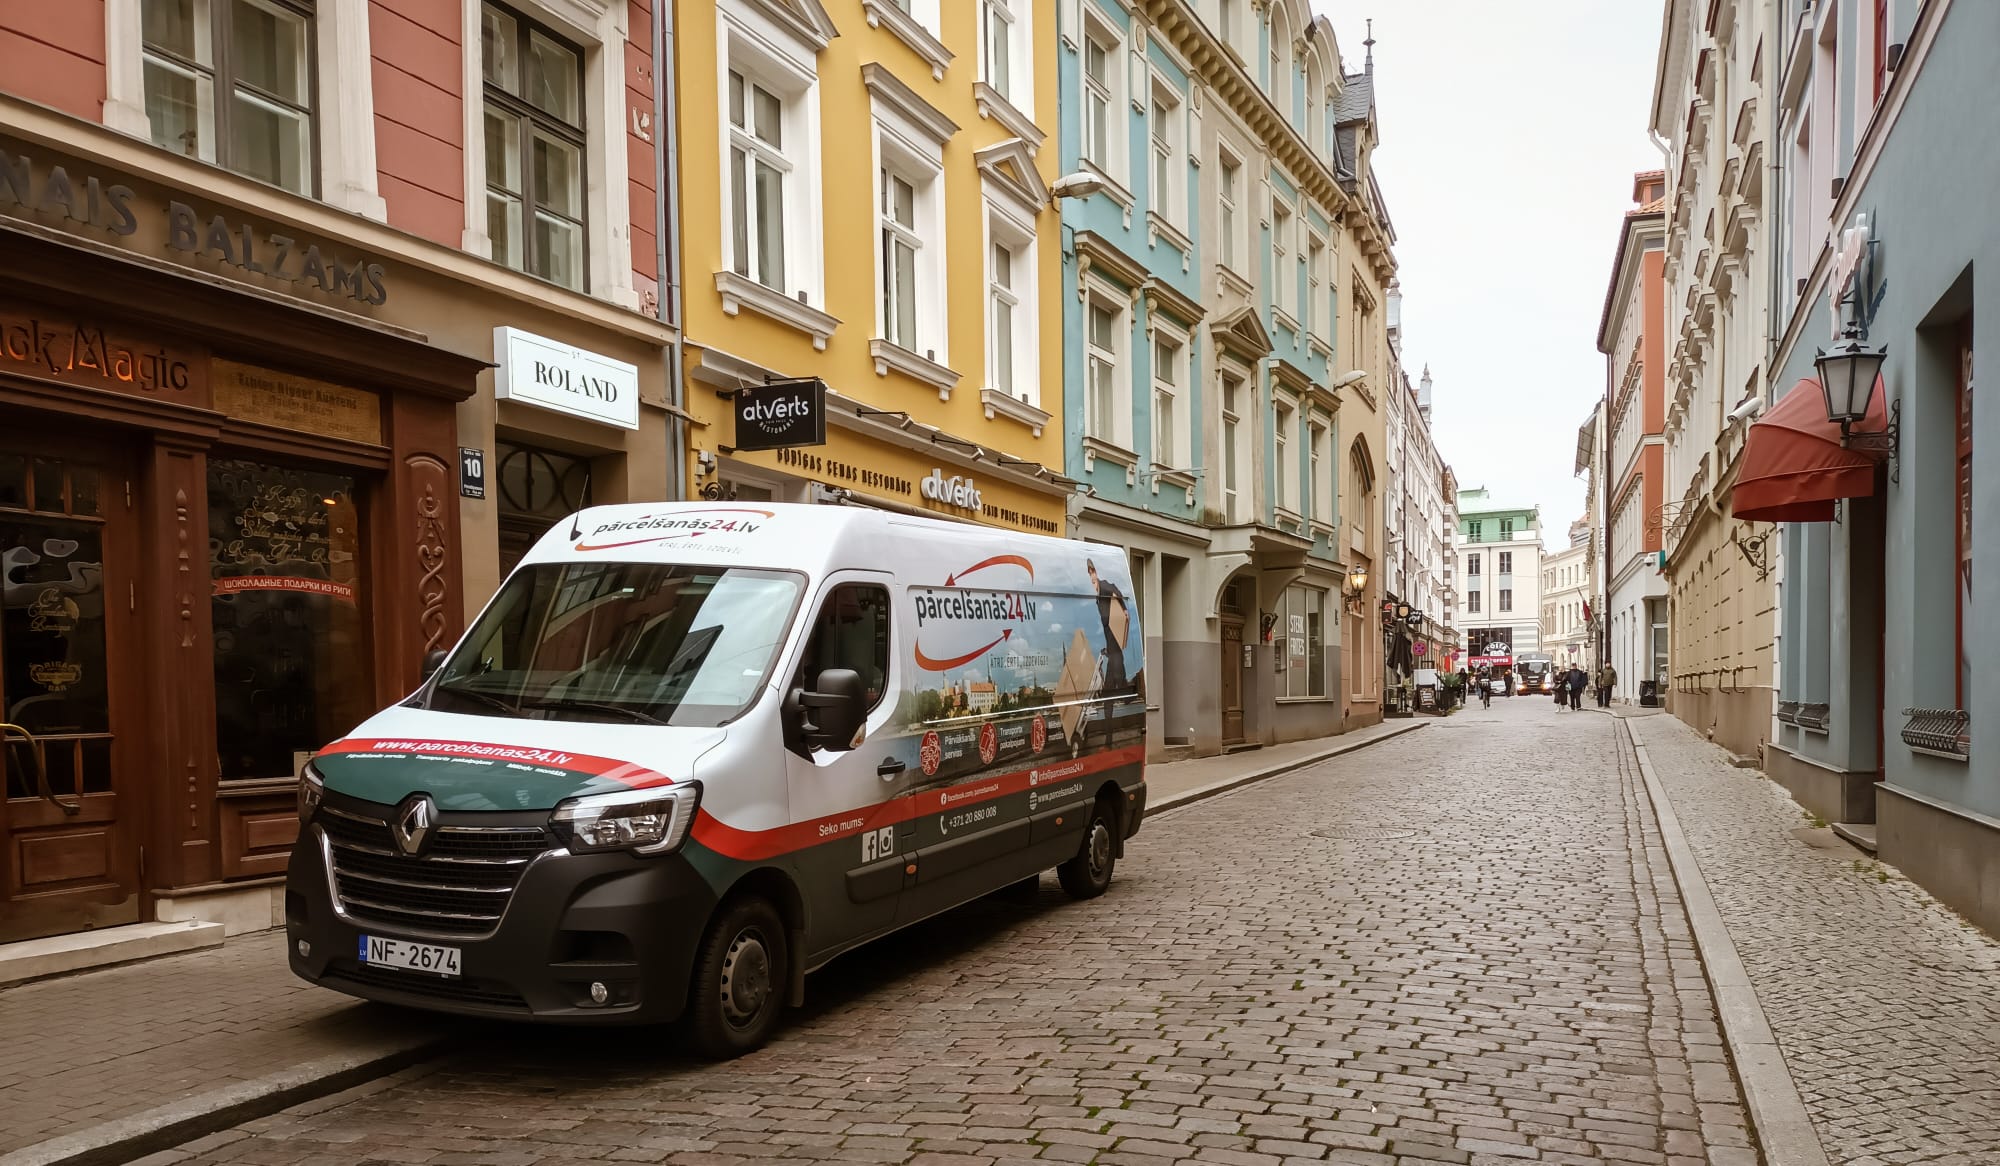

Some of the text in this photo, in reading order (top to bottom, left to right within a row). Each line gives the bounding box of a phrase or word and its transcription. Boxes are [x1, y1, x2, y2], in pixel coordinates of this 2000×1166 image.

[168, 200, 387, 305] BALZAMS
[0, 319, 189, 391] ck Magic
[534, 361, 617, 403] ROLAND
[464, 458, 481, 478] 10
[827, 459, 858, 482] CENAS
[592, 518, 760, 537] pārcelšanās24.lv
[982, 503, 1058, 533] FAIR PRICE RESTAURANT
[224, 579, 351, 596] ШОКОЛАДНЫЕ ПОДАРКИ ИЗ РИГИ
[915, 589, 1036, 627] pārcelšanās24.lv
[1486, 642, 1507, 651] COSTA
[373, 740, 573, 764] www.parcelsanas24.lv
[819, 817, 864, 837] Seko mums:
[949, 814, 965, 828] +371
[965, 812, 974, 824] 20
[371, 939, 457, 972] NF-2674
